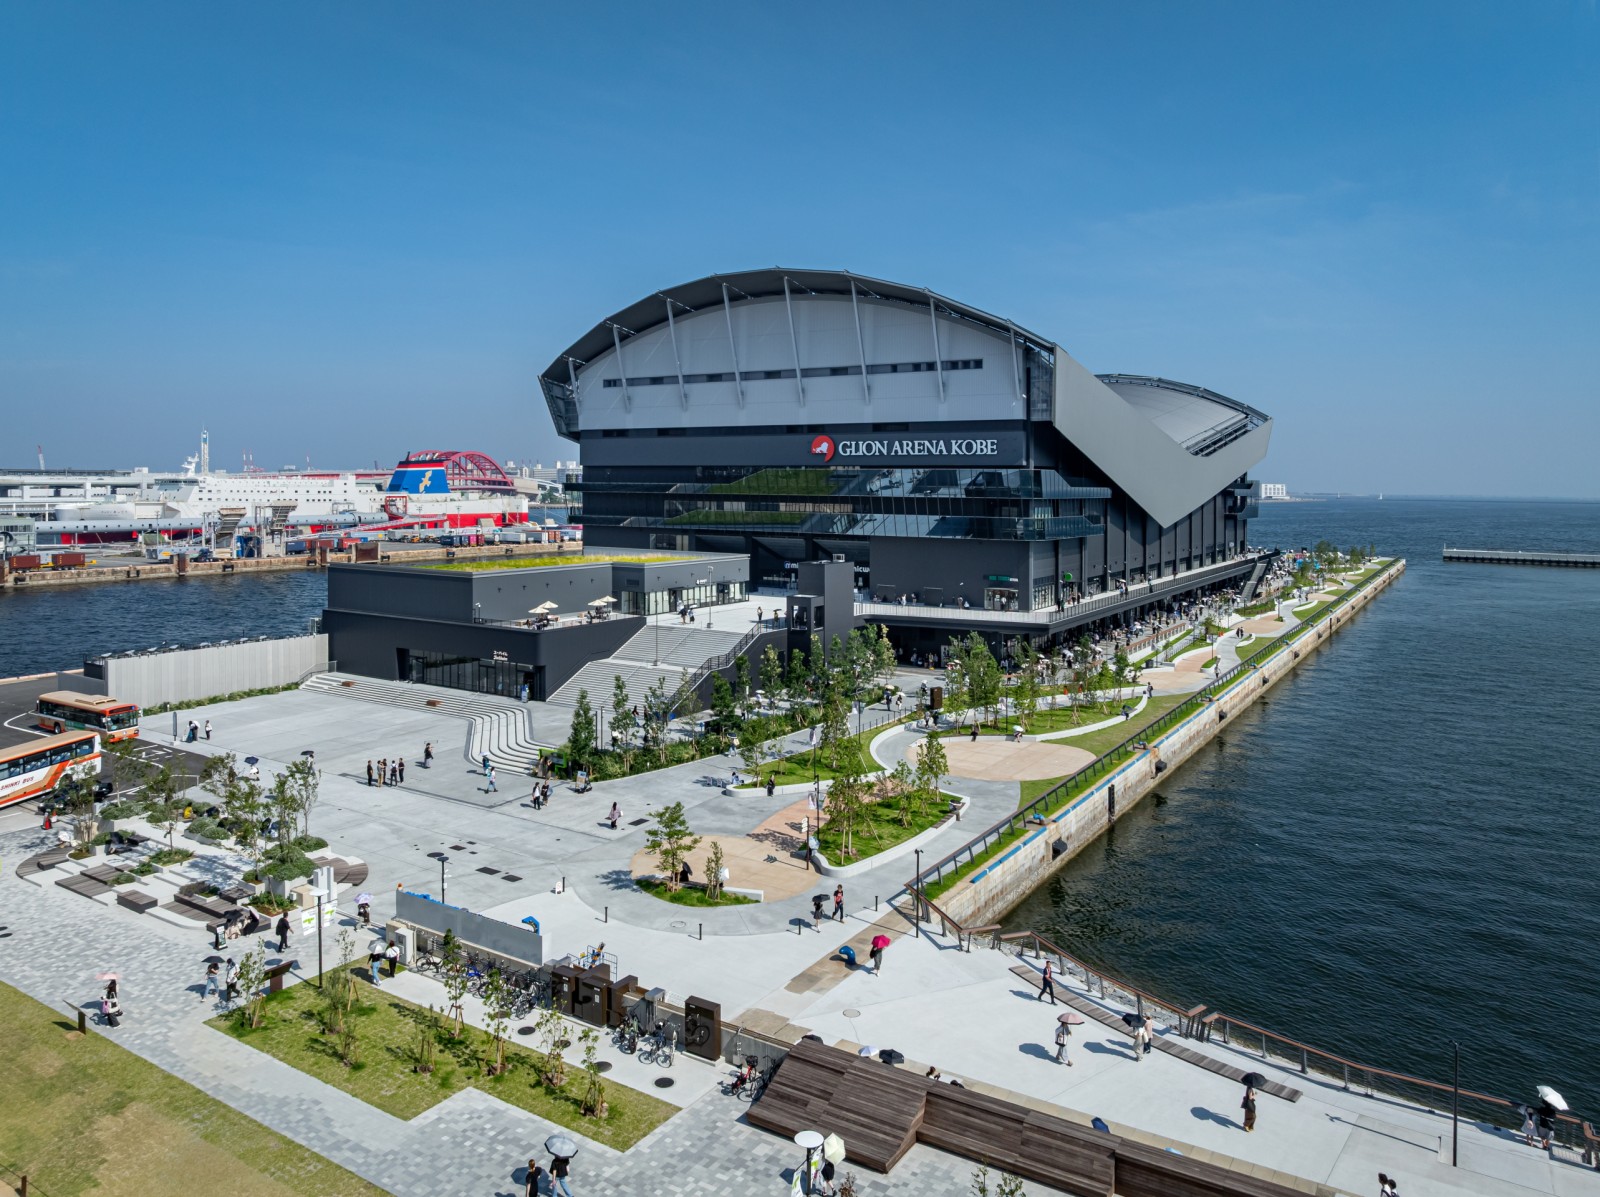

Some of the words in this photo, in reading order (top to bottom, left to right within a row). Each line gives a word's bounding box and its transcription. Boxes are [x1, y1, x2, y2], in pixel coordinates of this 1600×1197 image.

[838, 441, 888, 456] GLION
[891, 440, 948, 456] ARENA
[951, 439, 998, 455] KOBE
[22, 776, 35, 784] BUS
